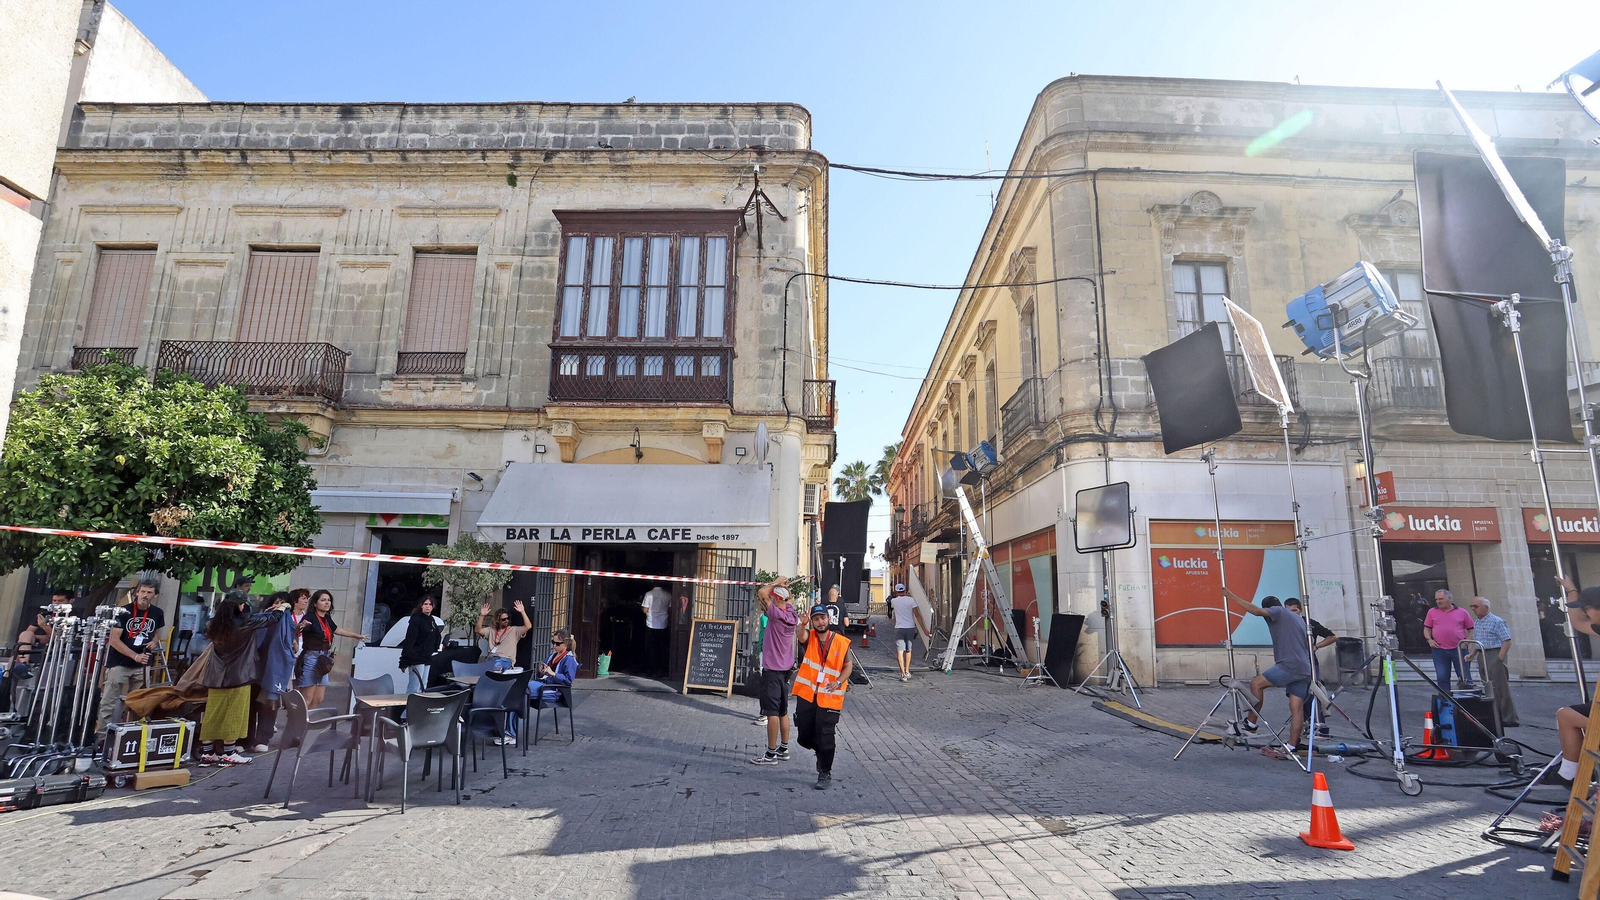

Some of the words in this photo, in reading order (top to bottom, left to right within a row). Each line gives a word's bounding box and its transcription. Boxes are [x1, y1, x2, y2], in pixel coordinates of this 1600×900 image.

[1347, 317, 1363, 330] ARRI
[1408, 514, 1462, 531] luckia
[1556, 516, 1600, 532] lucki
[506, 528, 540, 540] BAR
[550, 528, 571, 540] LA
[582, 528, 637, 540] PERLA
[647, 528, 692, 540] CAFE
[1173, 557, 1208, 569] luckia
